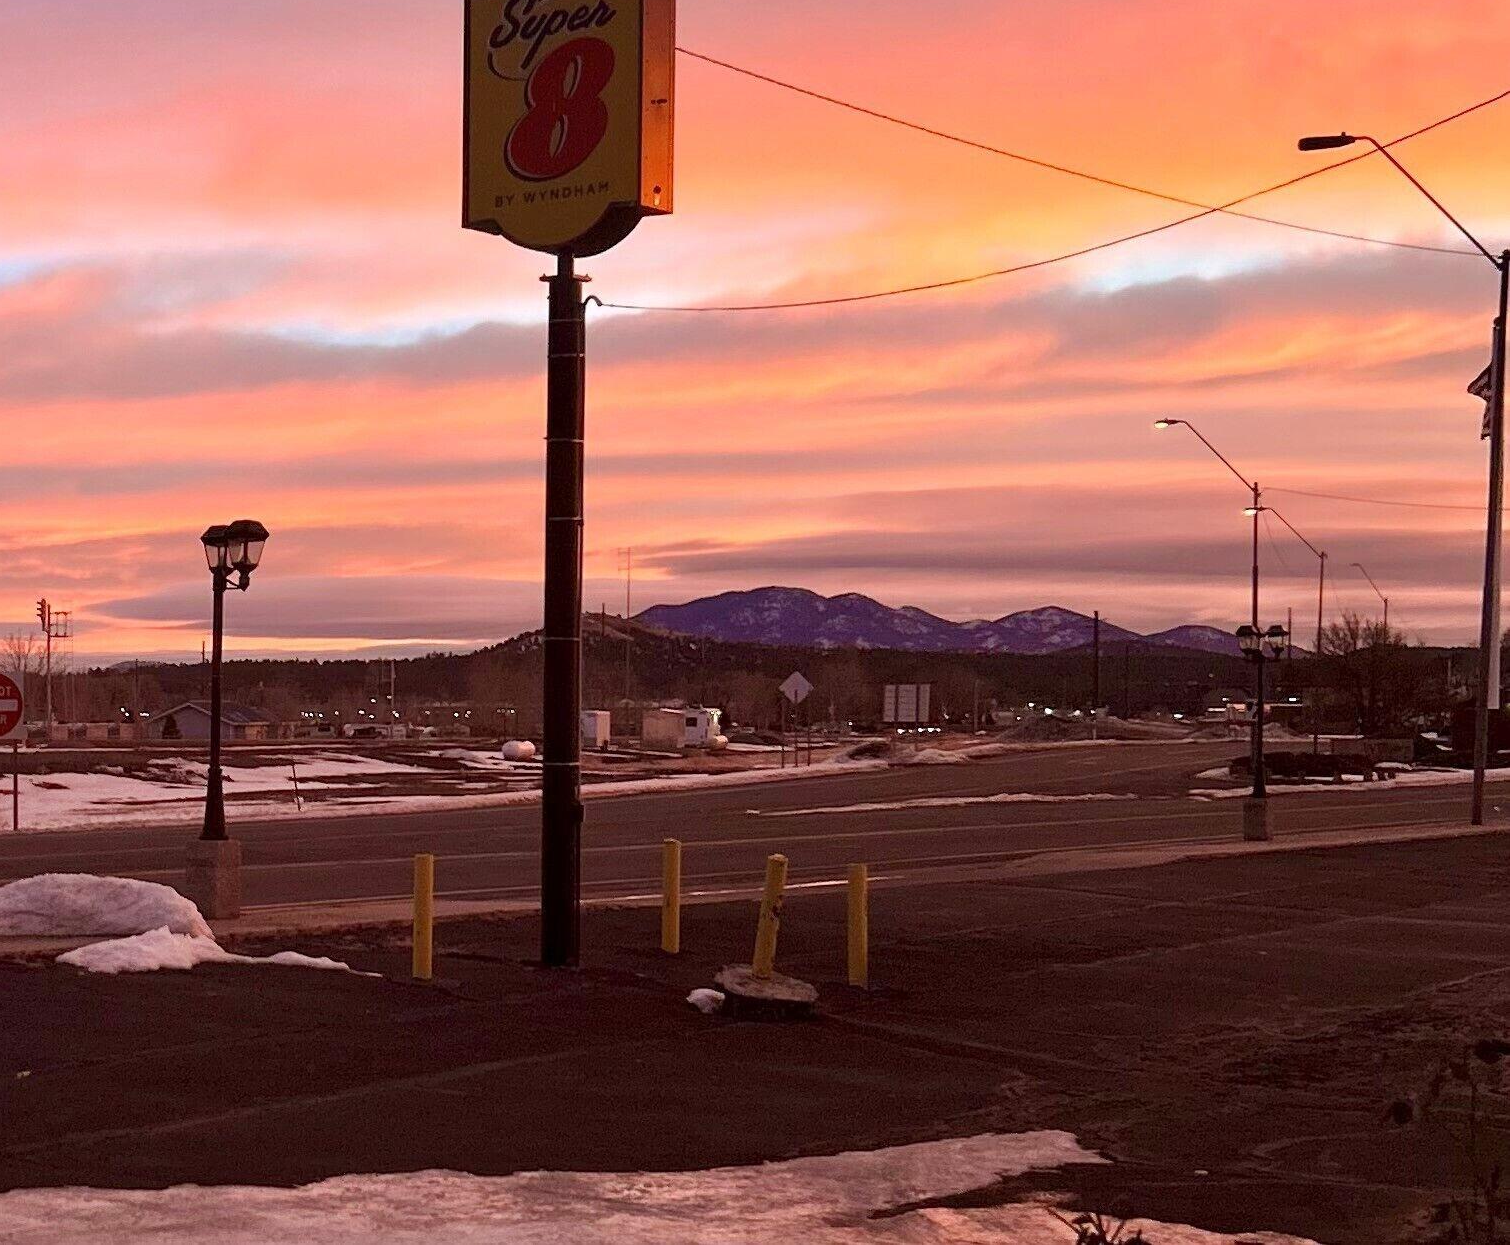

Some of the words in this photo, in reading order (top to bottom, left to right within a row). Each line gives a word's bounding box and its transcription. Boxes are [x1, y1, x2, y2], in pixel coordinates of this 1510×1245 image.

[504, 37, 614, 182] 8
[495, 193, 514, 208] BY
[524, 180, 610, 204] WYNDHAM
